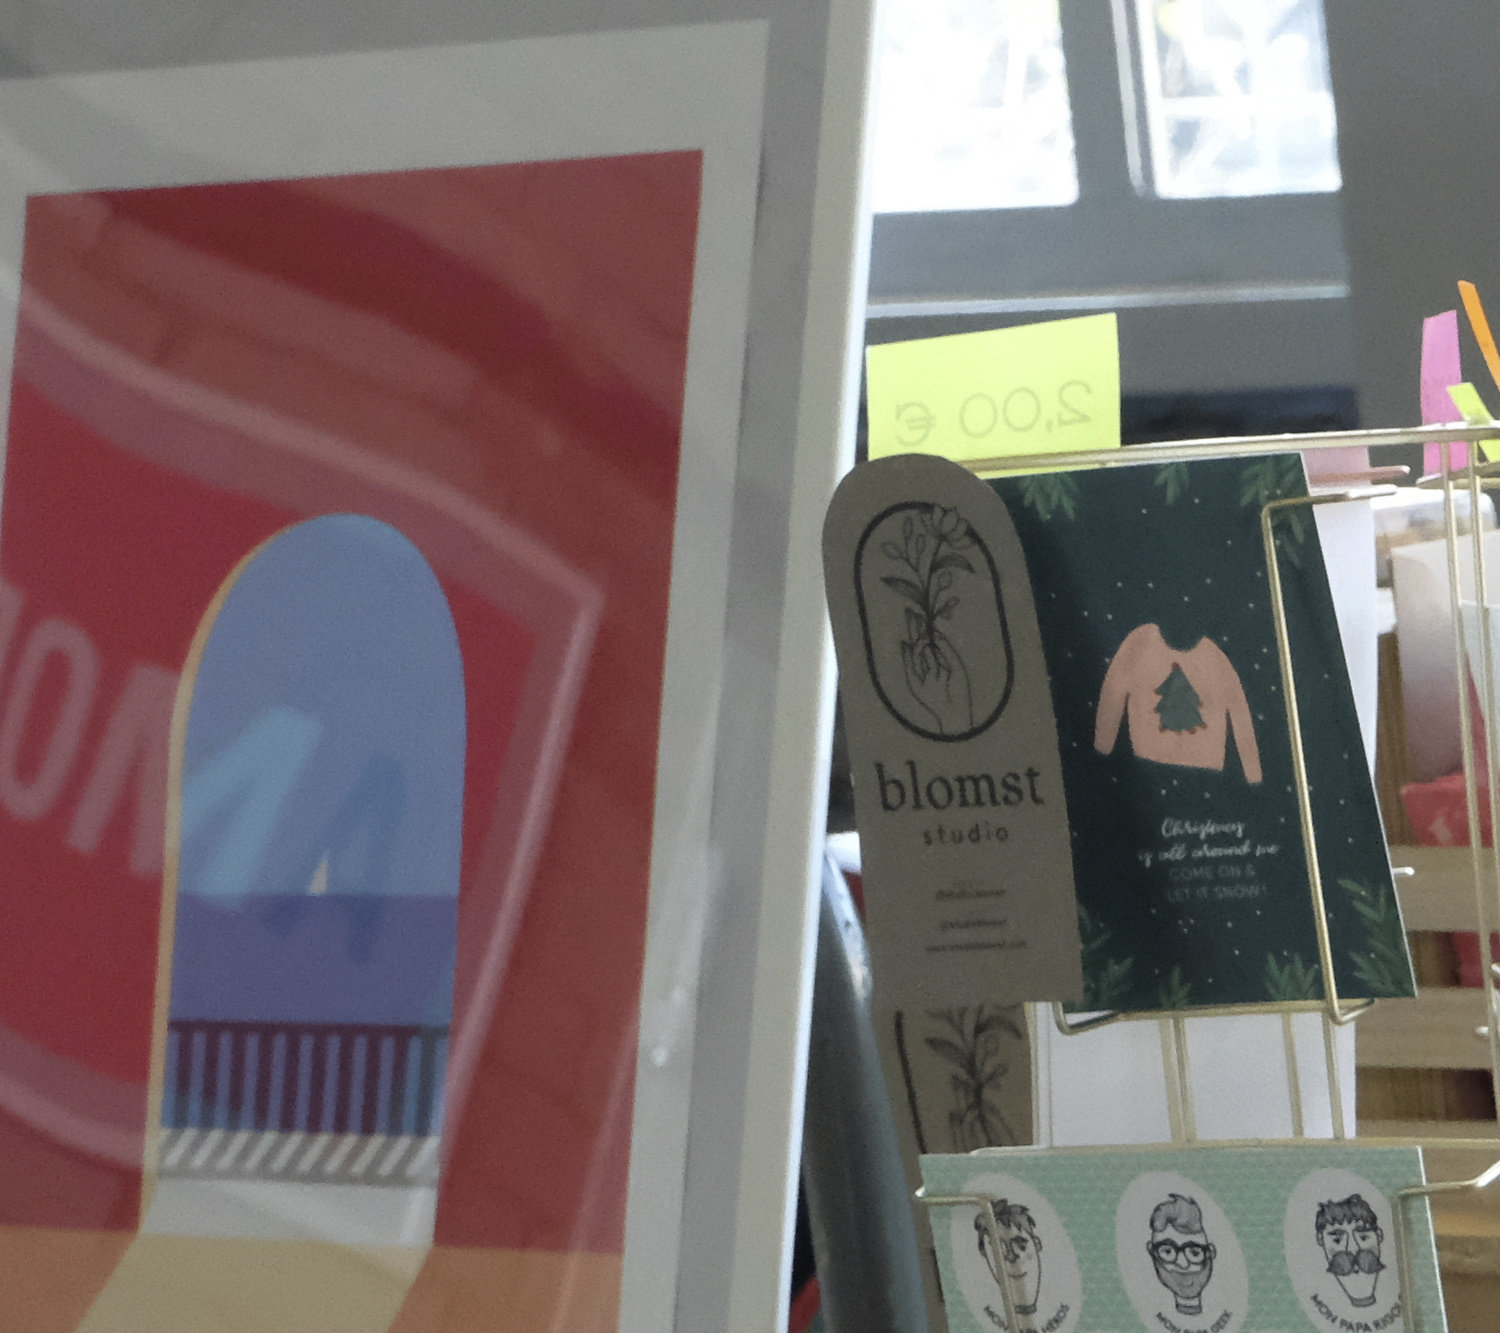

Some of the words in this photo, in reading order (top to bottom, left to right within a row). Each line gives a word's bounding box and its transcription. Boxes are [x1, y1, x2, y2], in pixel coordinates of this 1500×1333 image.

[875, 760, 1044, 812] blomst
[923, 822, 1008, 846] studio
[1311, 1293, 1338, 1324] MON
[1340, 1319, 1372, 1333] PAPA
